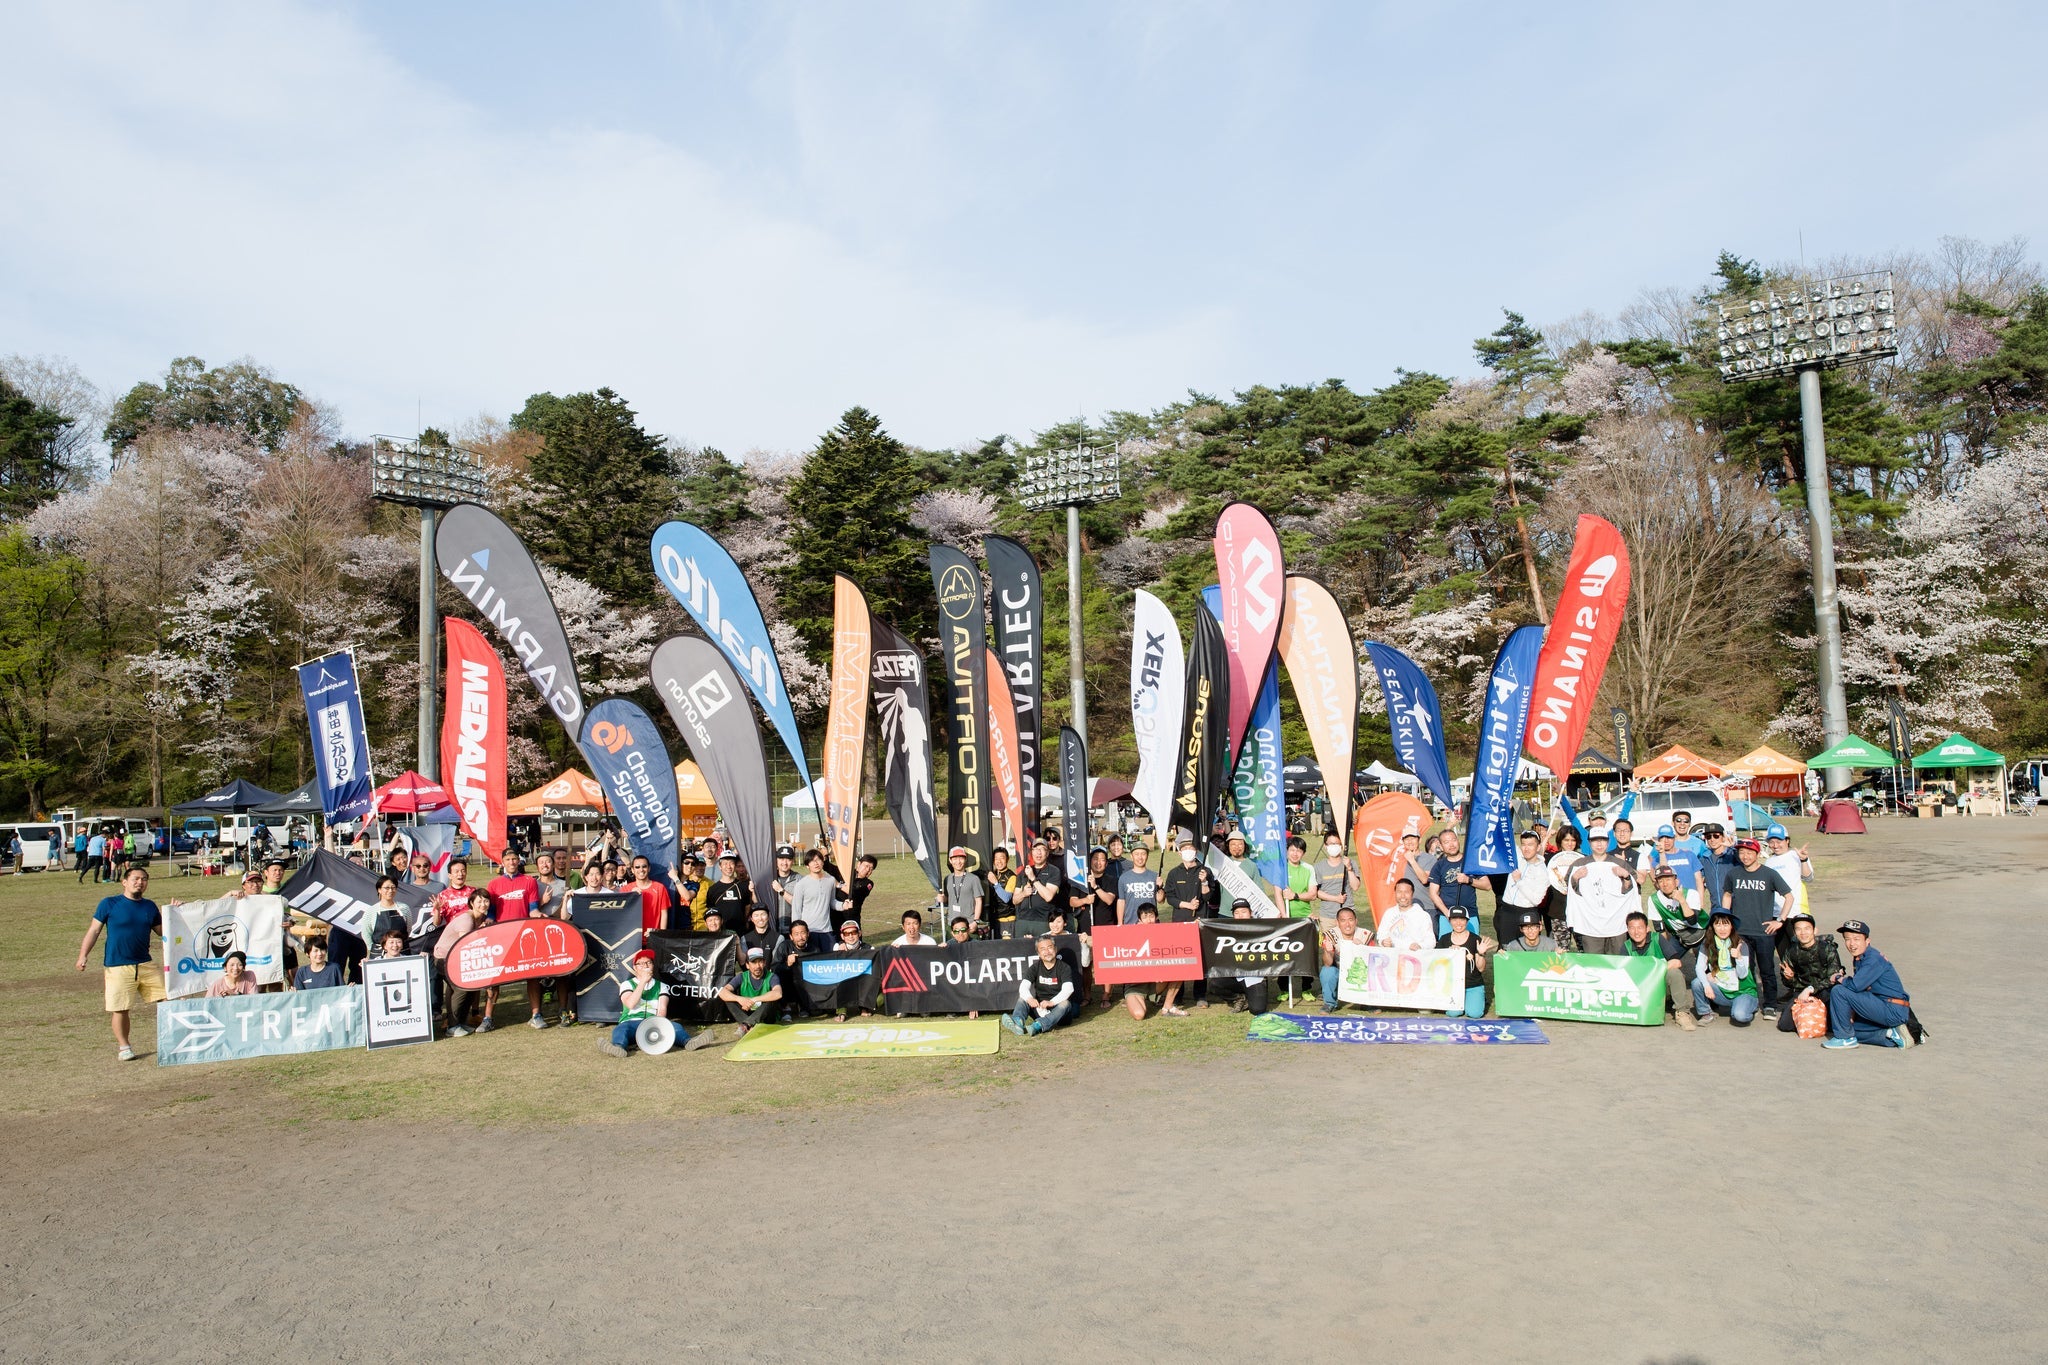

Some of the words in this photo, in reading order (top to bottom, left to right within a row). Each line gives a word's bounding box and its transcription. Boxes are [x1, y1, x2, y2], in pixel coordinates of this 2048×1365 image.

[1383, 668, 1416, 774] SEALSKINZ
[1184, 676, 1211, 790] VASQUE
[454, 658, 489, 842] MEDALIST
[1500, 816, 1509, 833] THE
[1516, 684, 1530, 739] EXPERIENCE
[612, 770, 652, 839] System
[626, 751, 674, 840] Champion
[1127, 881, 1155, 893] XERO
[1735, 879, 1766, 891] JANIS
[460, 944, 504, 960] DEMO
[1215, 936, 1304, 953] PaaGo
[461, 956, 494, 972] RUN
[808, 960, 864, 974] New-HALE
[930, 956, 1041, 986] POLARTE
[658, 984, 723, 999] RC'TERYX
[1524, 984, 1641, 1009] Trippers
[236, 1001, 356, 1043] TREAT
[377, 1016, 421, 1028] komeama
[1525, 1004, 1544, 1012] West
[1602, 1010, 1638, 1019] Company
